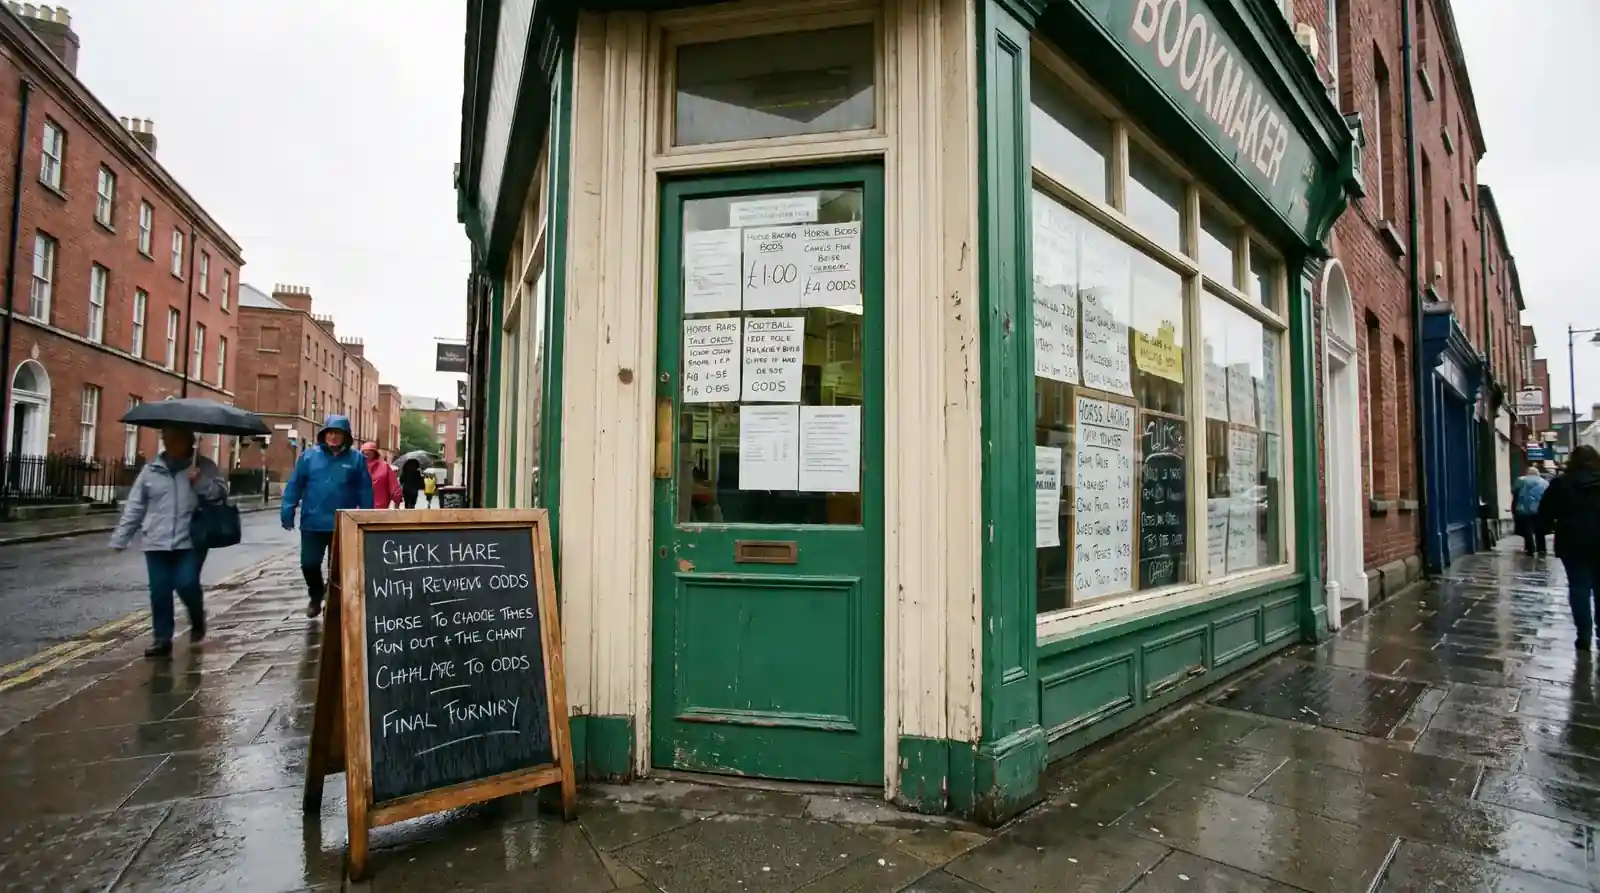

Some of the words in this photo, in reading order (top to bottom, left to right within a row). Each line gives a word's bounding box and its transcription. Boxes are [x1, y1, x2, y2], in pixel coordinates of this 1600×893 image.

[1132, 0, 1288, 187] BOOKMAKER
[449, 543, 501, 563] HARE
[373, 578, 414, 600] WITH
[489, 573, 529, 590] ODDS
[374, 615, 423, 634] HORSE
[373, 638, 404, 656] RUN
[410, 635, 439, 650] OUT
[454, 630, 483, 645] THE
[486, 627, 527, 642] CHANT
[463, 657, 484, 676] TO
[491, 655, 531, 673] ODDS
[383, 709, 438, 739] FINAL
